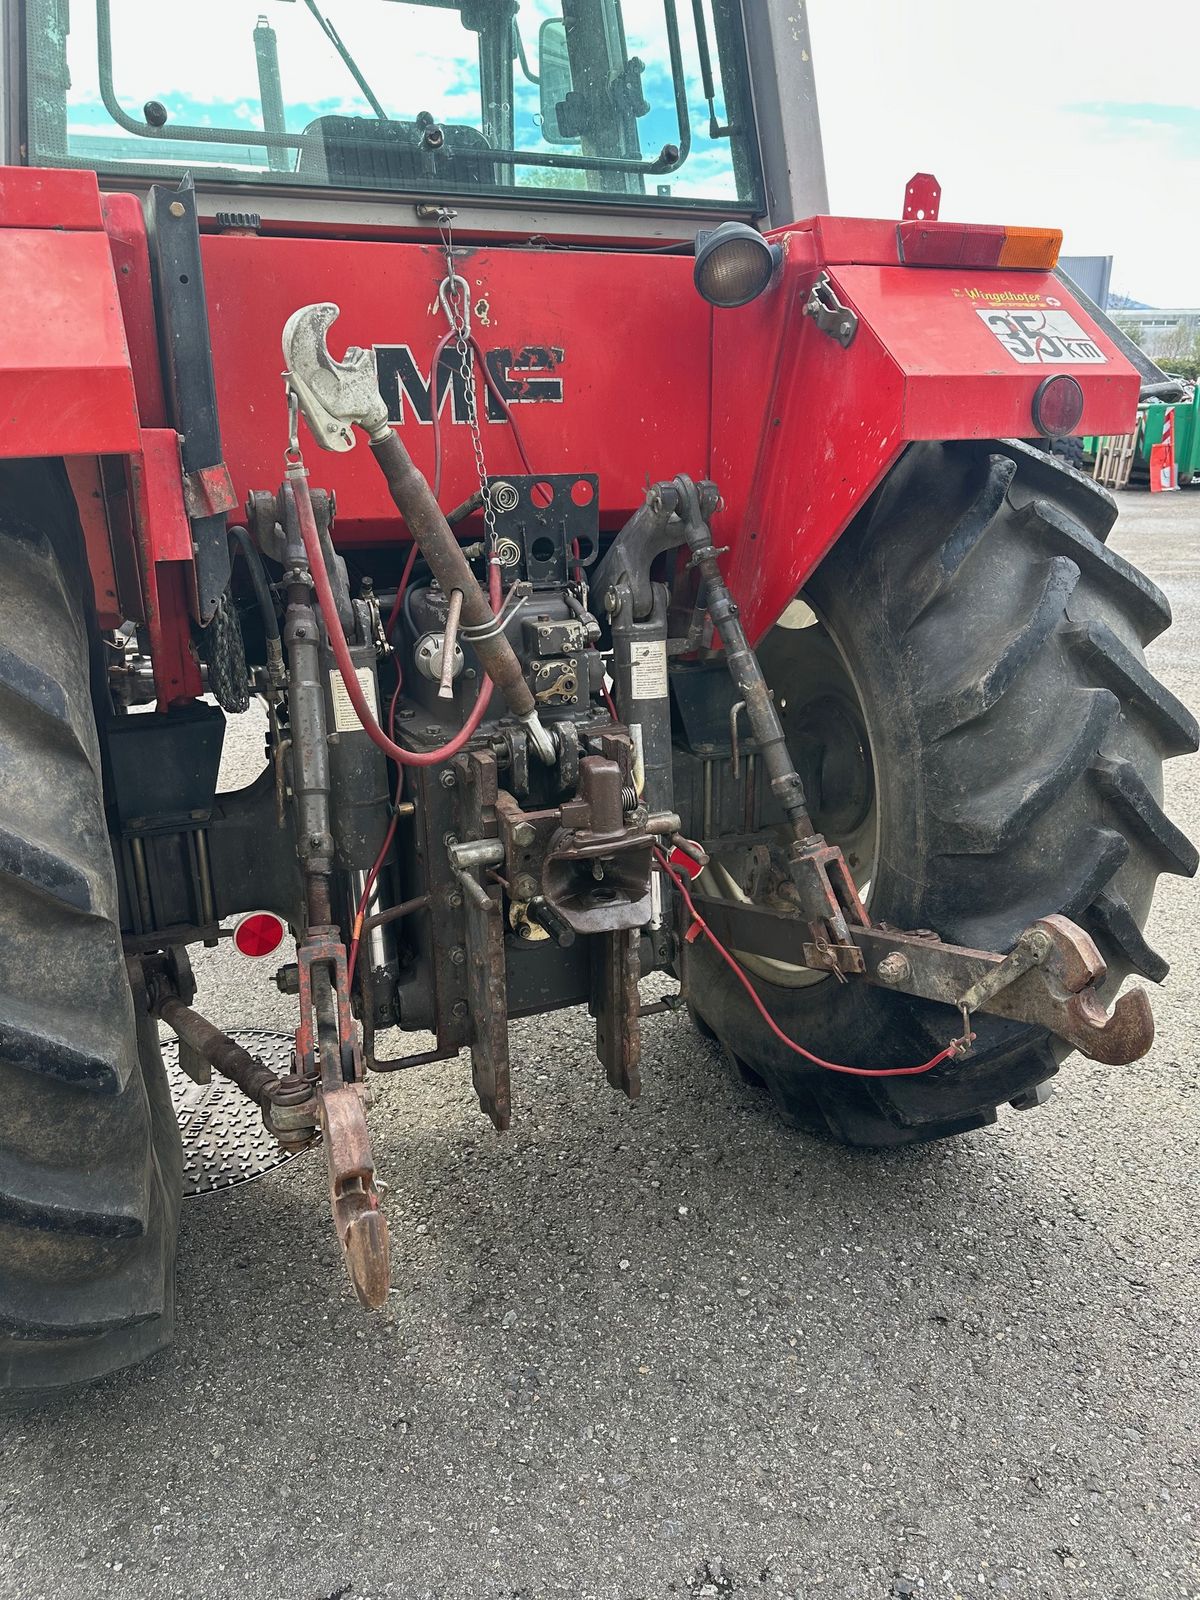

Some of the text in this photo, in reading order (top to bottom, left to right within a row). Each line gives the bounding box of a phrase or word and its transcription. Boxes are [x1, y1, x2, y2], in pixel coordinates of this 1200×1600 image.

[964, 287, 1041, 303] Wingelhofer
[988, 315, 1102, 358] 35 km
[372, 344, 565, 426] MF
[185, 1110, 213, 1139] EURO
[205, 1087, 226, 1108] TOP
